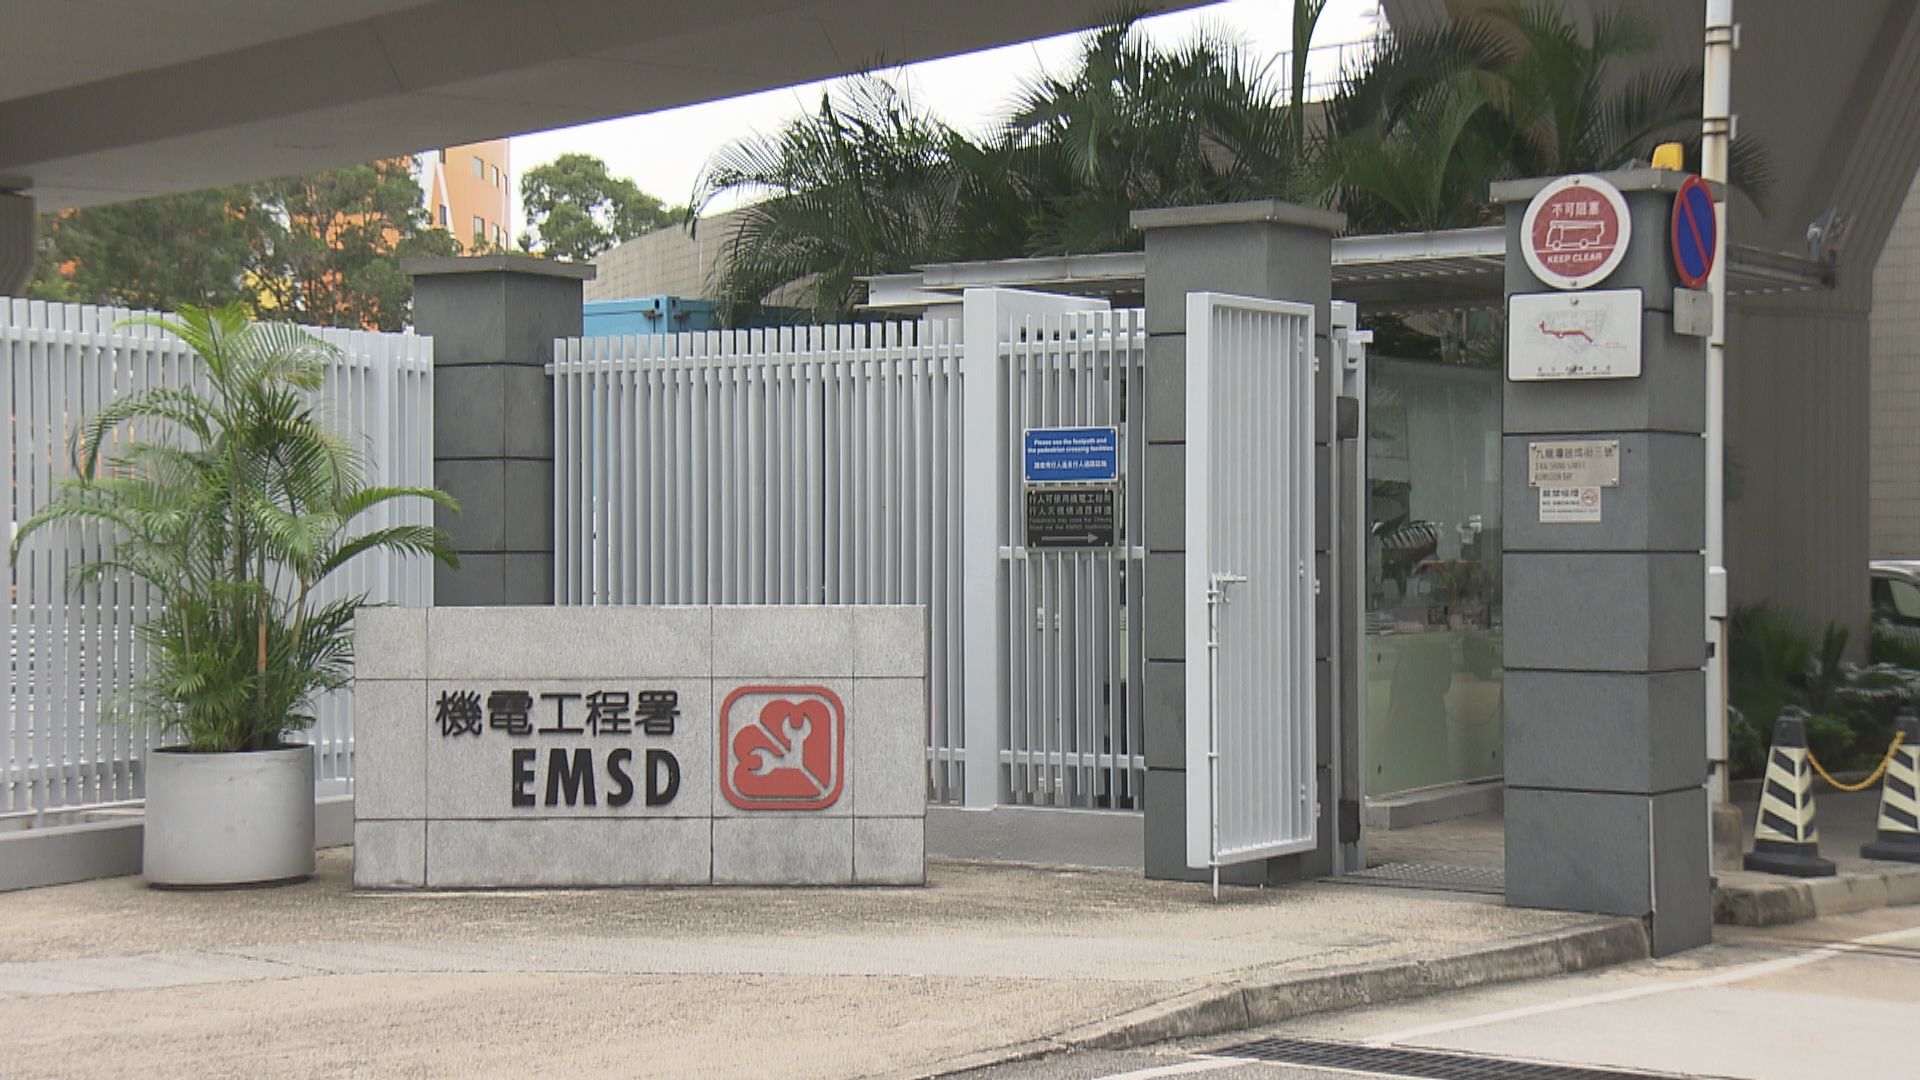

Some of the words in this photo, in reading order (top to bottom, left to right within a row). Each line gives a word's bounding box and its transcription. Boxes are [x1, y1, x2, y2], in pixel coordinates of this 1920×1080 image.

[1551, 201, 1600, 218] 不可阻塞
[1547, 253, 1571, 264] KEEP
[1572, 252, 1602, 263] CLEAR
[1073, 438, 1095, 446] footpath
[1037, 446, 1065, 455] pedestrian
[1066, 446, 1089, 455] crossing
[435, 689, 681, 737] 機電工程署
[512, 748, 681, 807] EMSD
